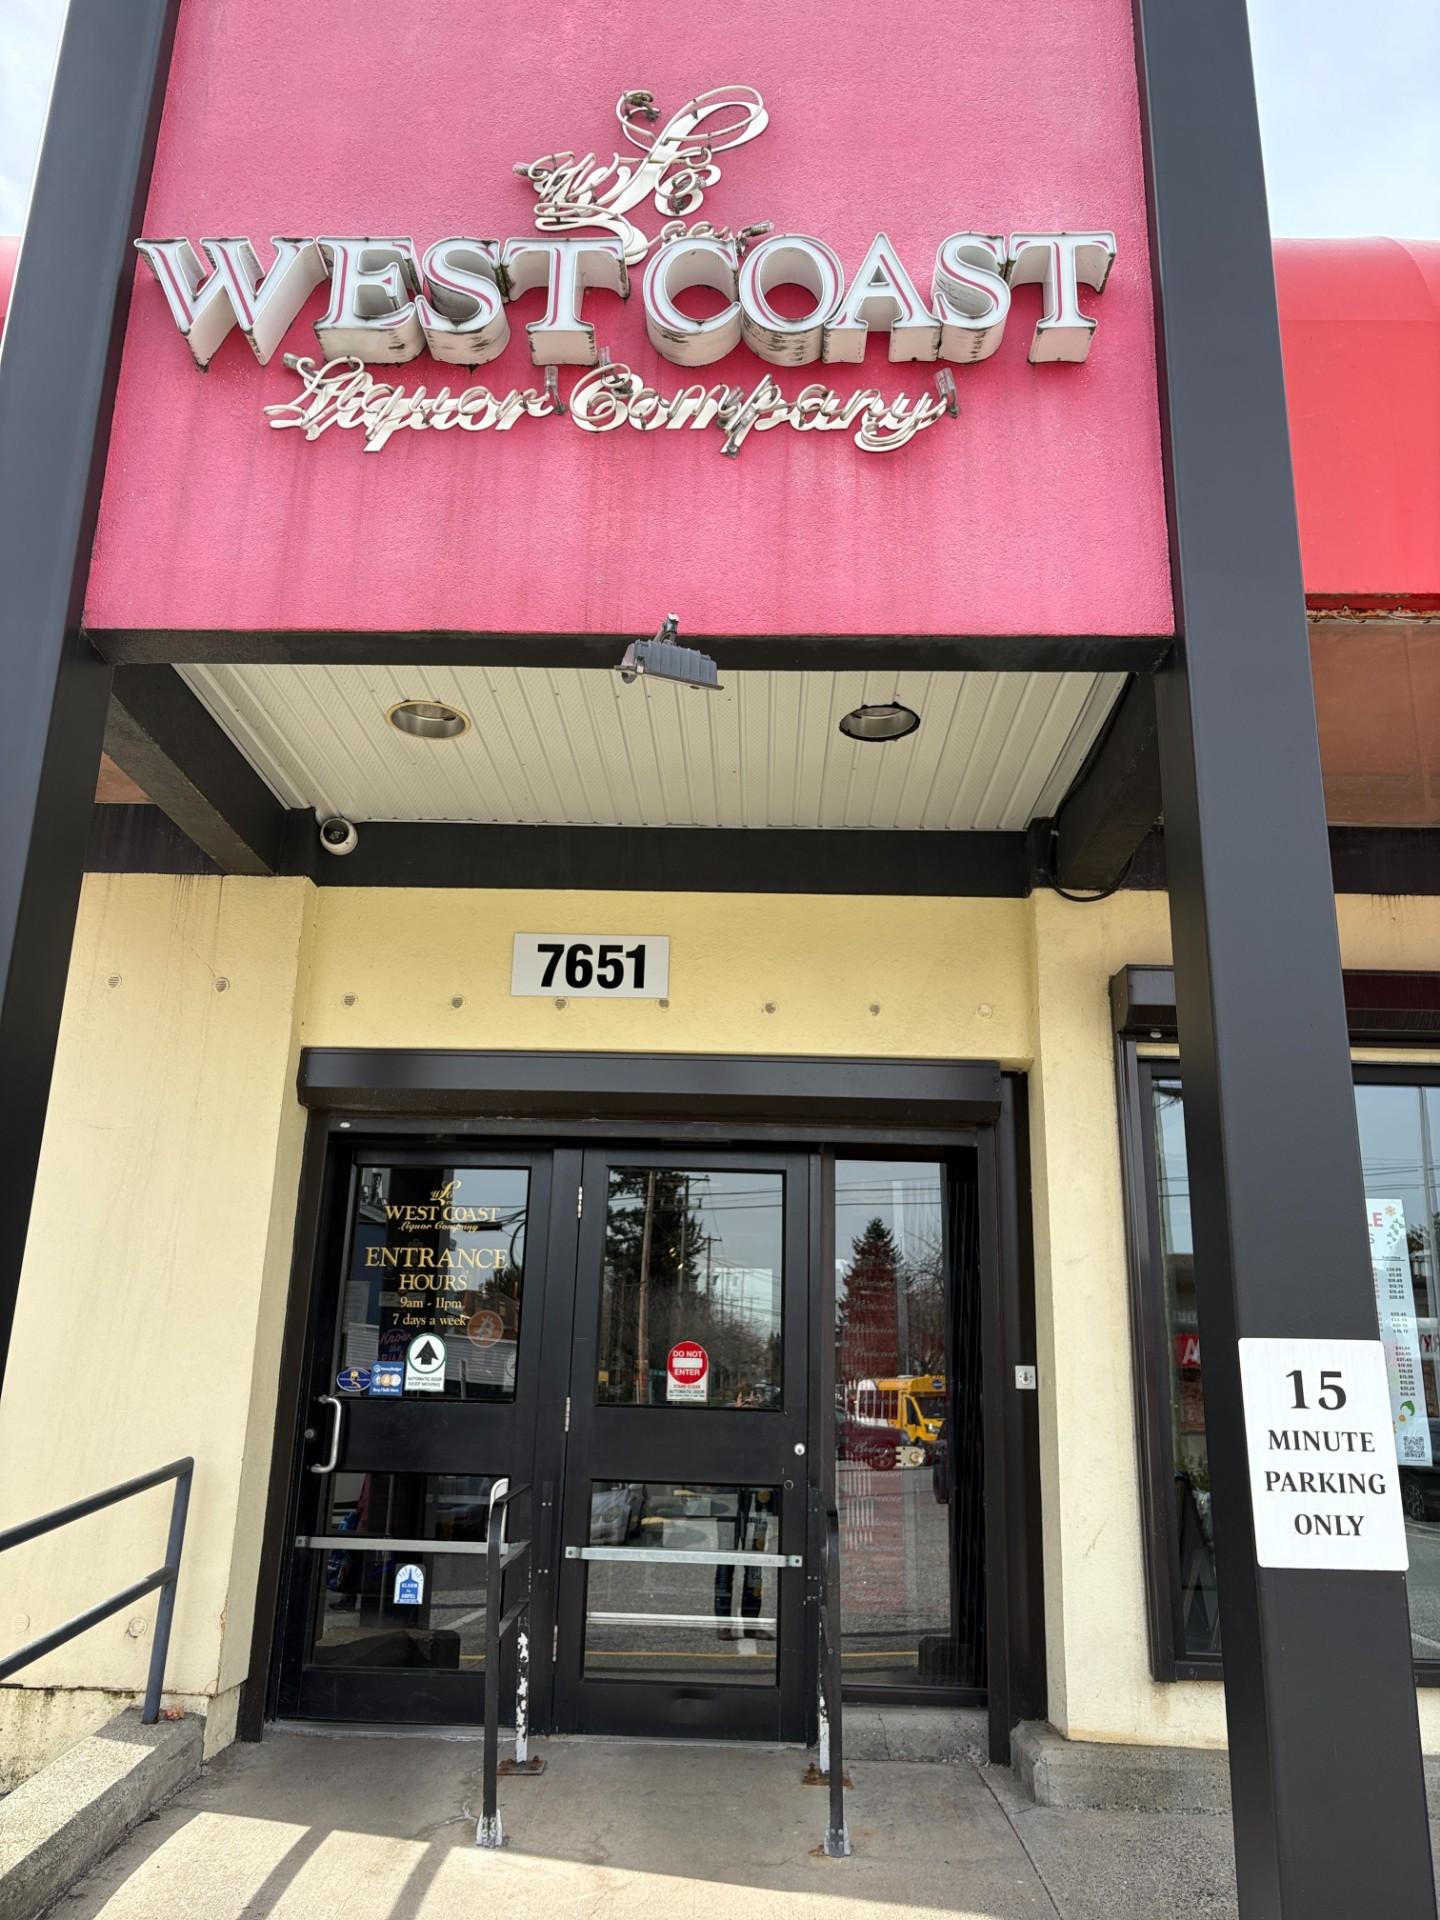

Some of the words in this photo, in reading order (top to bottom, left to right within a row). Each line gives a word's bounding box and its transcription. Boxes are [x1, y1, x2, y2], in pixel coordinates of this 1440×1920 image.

[134, 236, 631, 369] WEST
[643, 231, 1118, 366] COAST
[264, 354, 558, 453] Liquor
[568, 362, 956, 457] Company
[537, 943, 646, 989] 7651
[384, 1205, 439, 1220] WEST
[442, 1206, 501, 1222] COAST
[398, 1221, 432, 1232] Liquor
[434, 1221, 478, 1233] Company
[365, 1246, 508, 1269] ENTRANCE
[399, 1273, 468, 1291] HOURS
[400, 1296, 424, 1309] 9am
[435, 1297, 462, 1311] 11pm
[392, 1313, 400, 1326] 7
[402, 1313, 426, 1328] days
[429, 1317, 436, 1326] a
[439, 1313, 467, 1326] week
[686, 1350, 703, 1358] NOT
[674, 1368, 701, 1376] ENTER
[1285, 1369, 1347, 1411] 15
[1267, 1429, 1375, 1453] MINUTE
[1265, 1471, 1386, 1495] PARKING
[1294, 1513, 1365, 1536] ONLY
